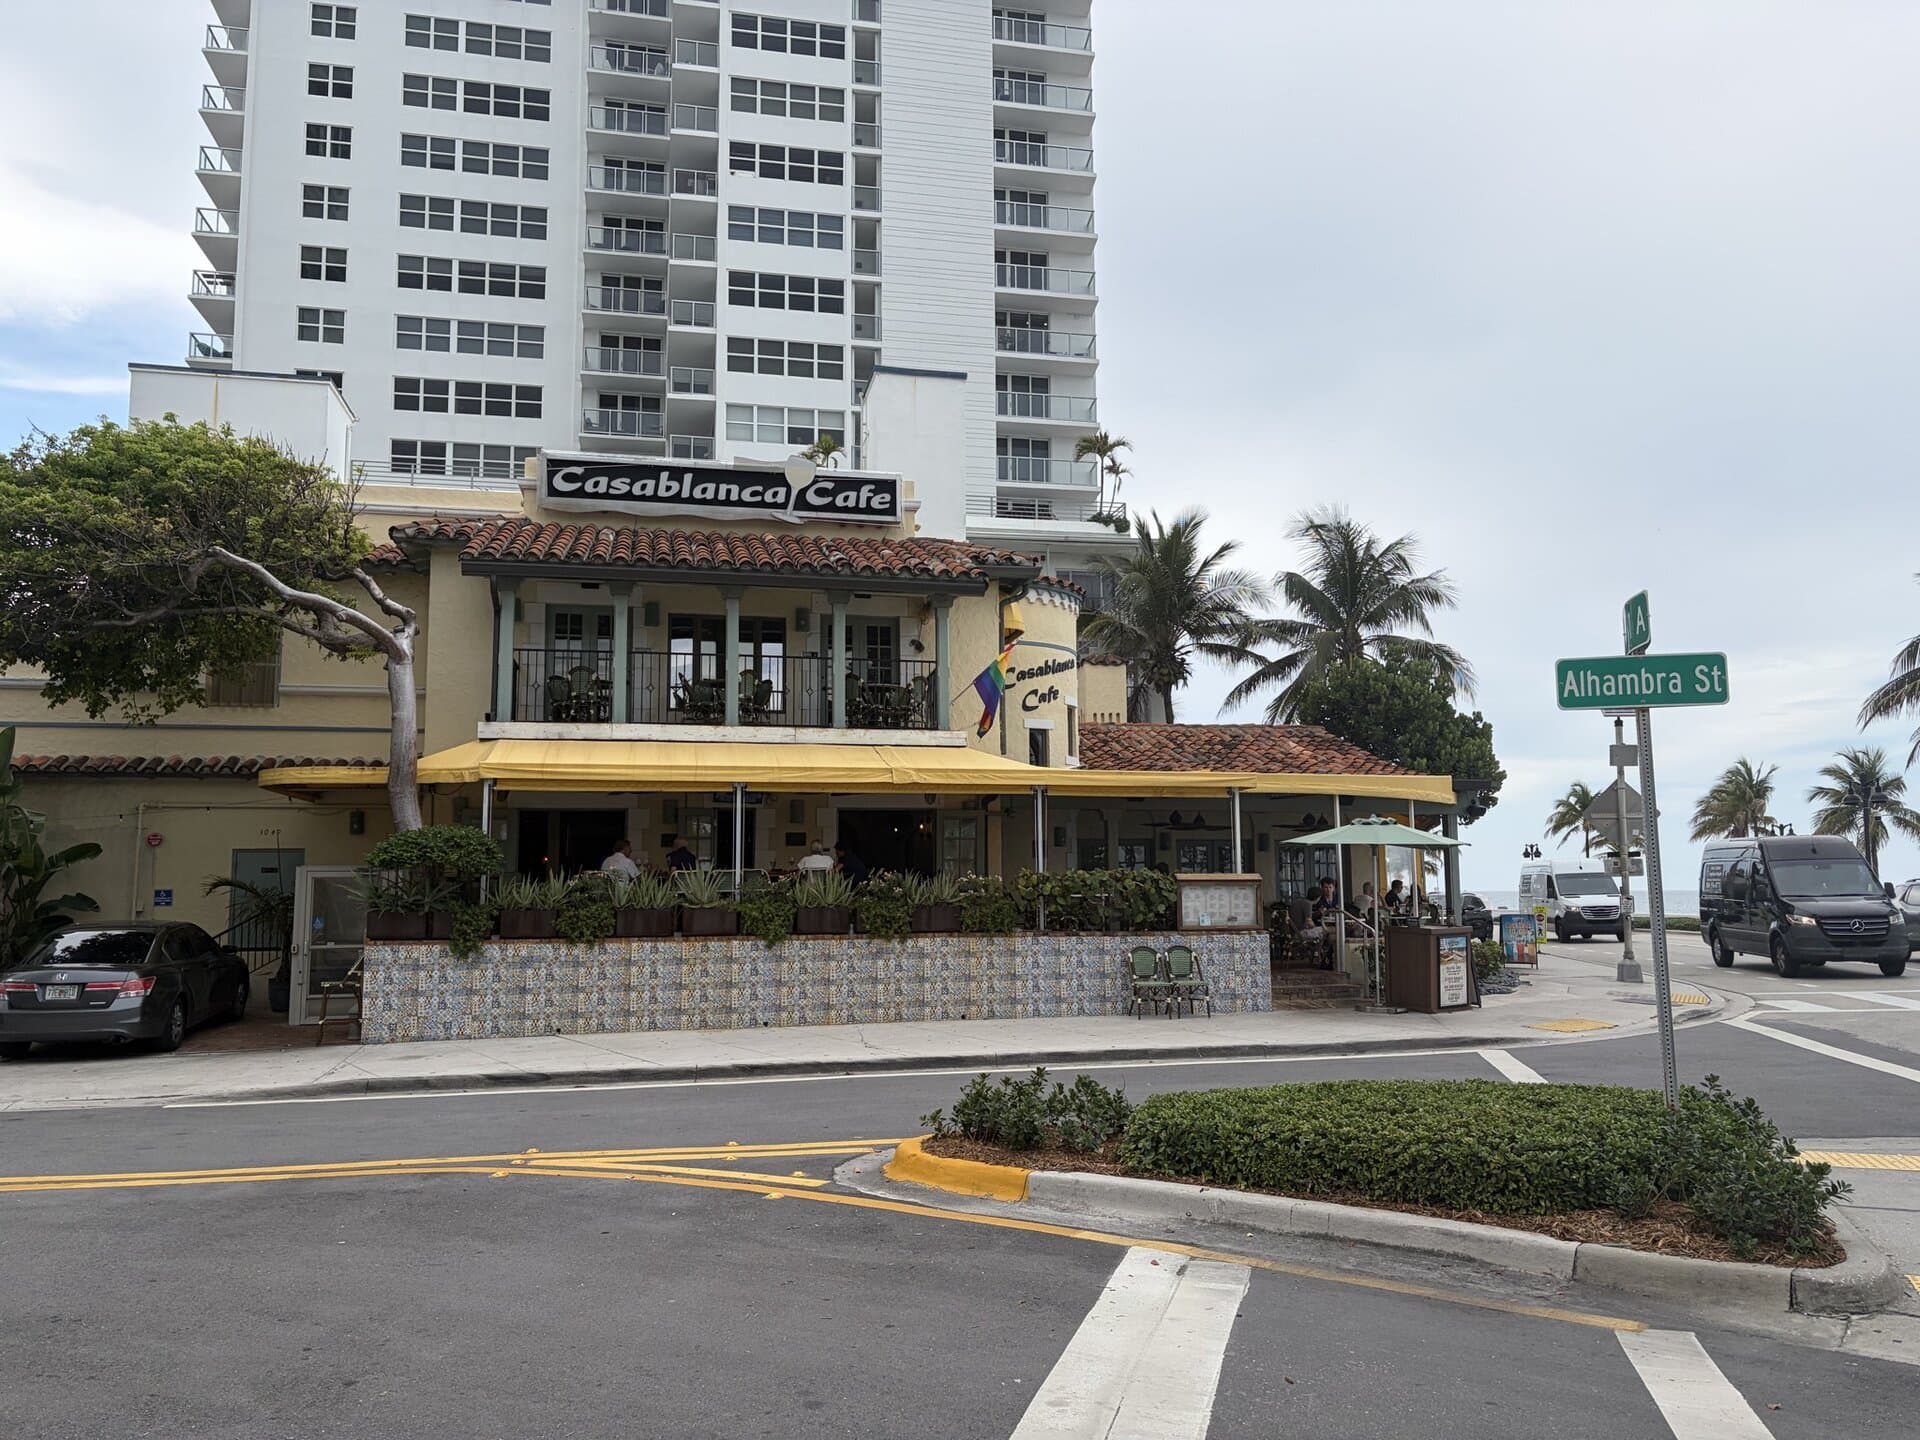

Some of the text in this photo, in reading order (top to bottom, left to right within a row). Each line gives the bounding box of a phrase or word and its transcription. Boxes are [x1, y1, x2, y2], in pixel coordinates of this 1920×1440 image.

[552, 466, 892, 510] Casablanca Cafe
[1635, 605, 1646, 635] A
[1004, 659, 1075, 690] Casablanca
[1563, 664, 1723, 698] Alhambra St
[1022, 685, 1060, 712] Cafe
